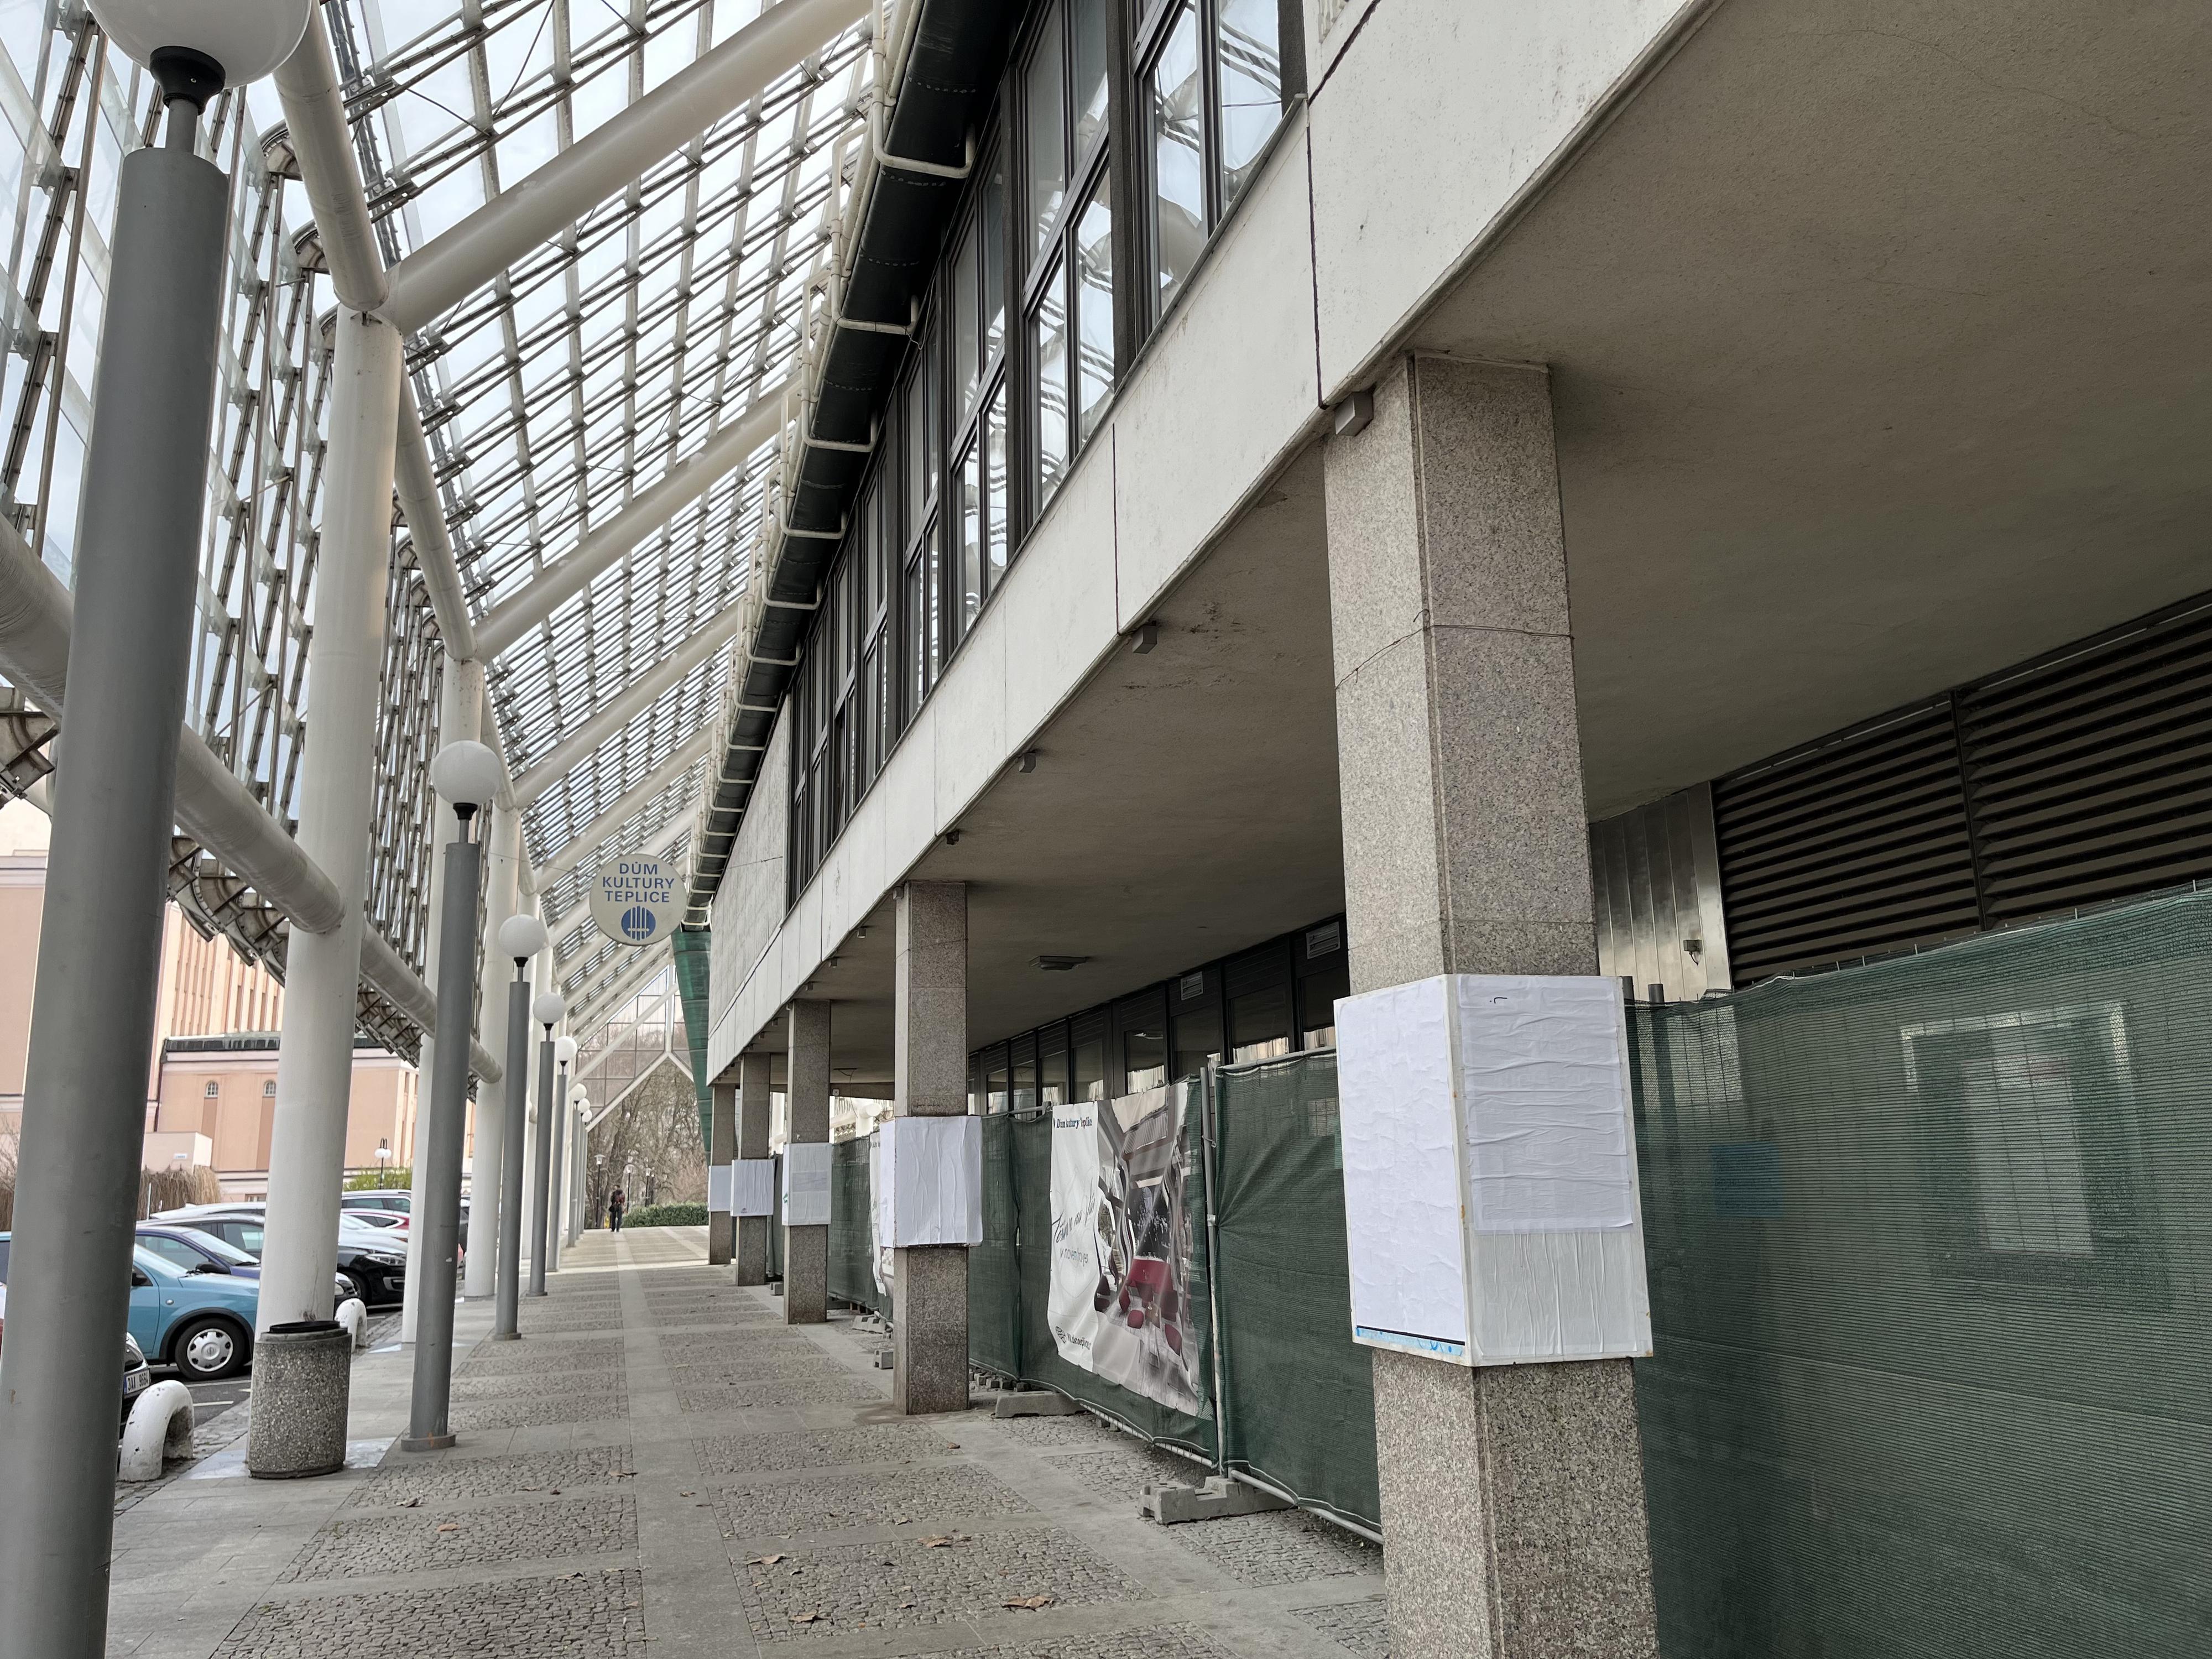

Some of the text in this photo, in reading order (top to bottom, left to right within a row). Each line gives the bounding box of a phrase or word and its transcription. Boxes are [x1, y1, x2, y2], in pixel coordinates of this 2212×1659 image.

[619, 862, 658, 875] DŮM
[602, 877, 675, 889] KULTURY
[604, 890, 670, 903] TEPLICE
